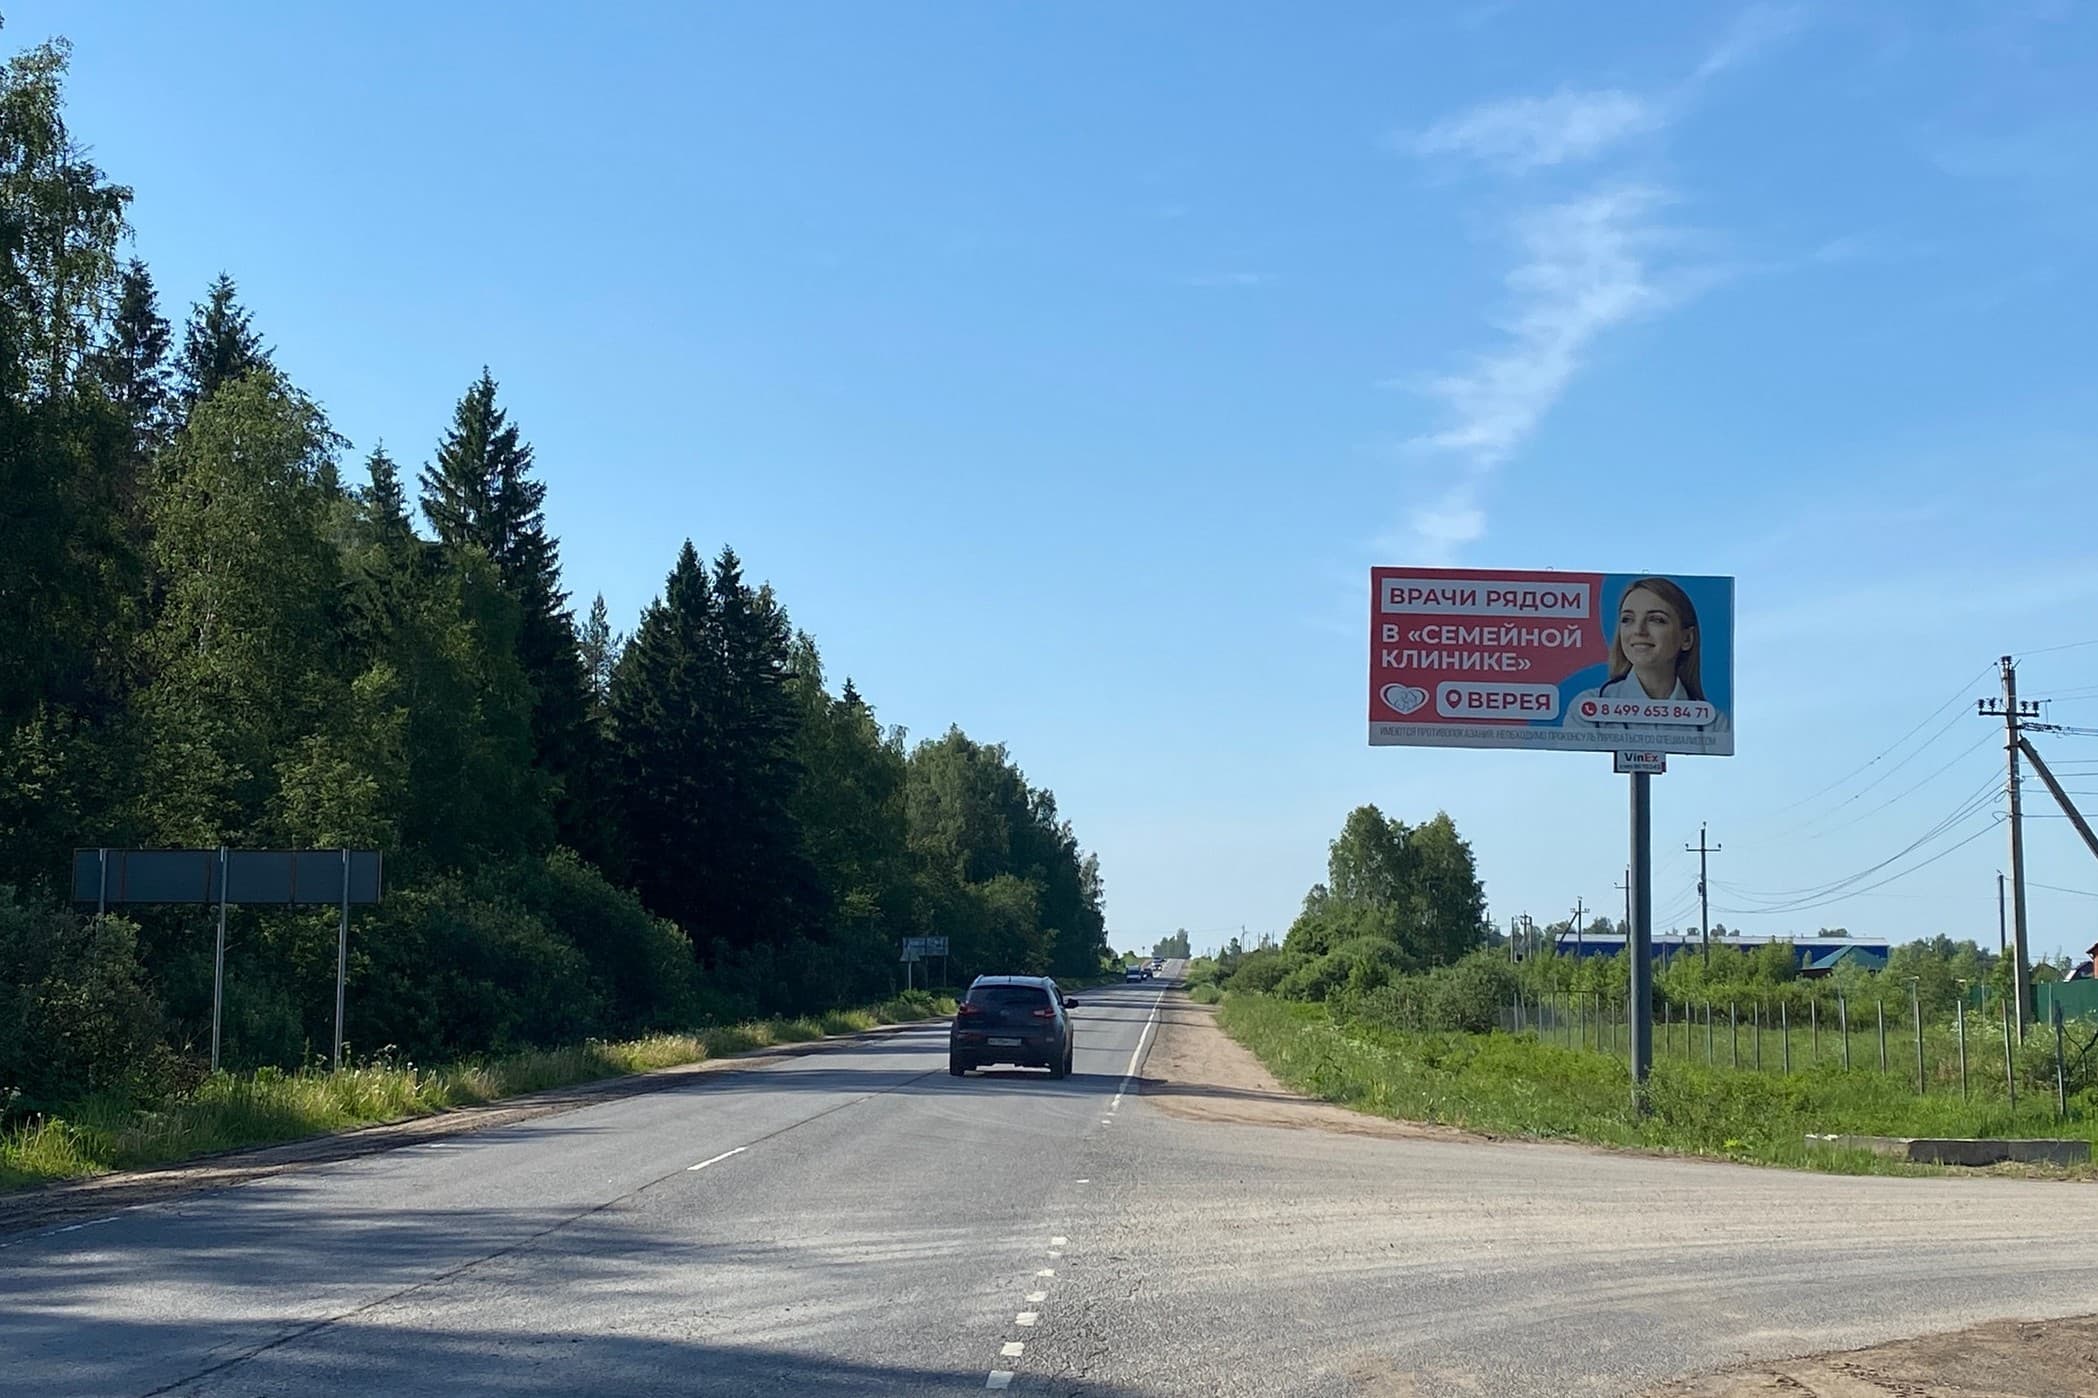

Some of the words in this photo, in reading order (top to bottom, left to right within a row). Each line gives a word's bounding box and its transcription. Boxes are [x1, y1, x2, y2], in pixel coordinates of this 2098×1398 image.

[1389, 587, 1477, 607] ВРАЧИ
[1486, 590, 1582, 612] РЯДОМ
[1382, 624, 1400, 642] В
[1408, 623, 1583, 649] «СЕМЕЙНОЙ
[1381, 649, 1532, 672] КЛИНИКЕ»
[1468, 691, 1551, 711] ВЕРЕЯ
[1601, 704, 1610, 715] 8
[1614, 704, 1640, 716] 499
[1643, 705, 1669, 717] 653
[1673, 706, 1691, 718] 84
[1696, 707, 1709, 719] 71
[1624, 752, 1658, 763] VinEx
